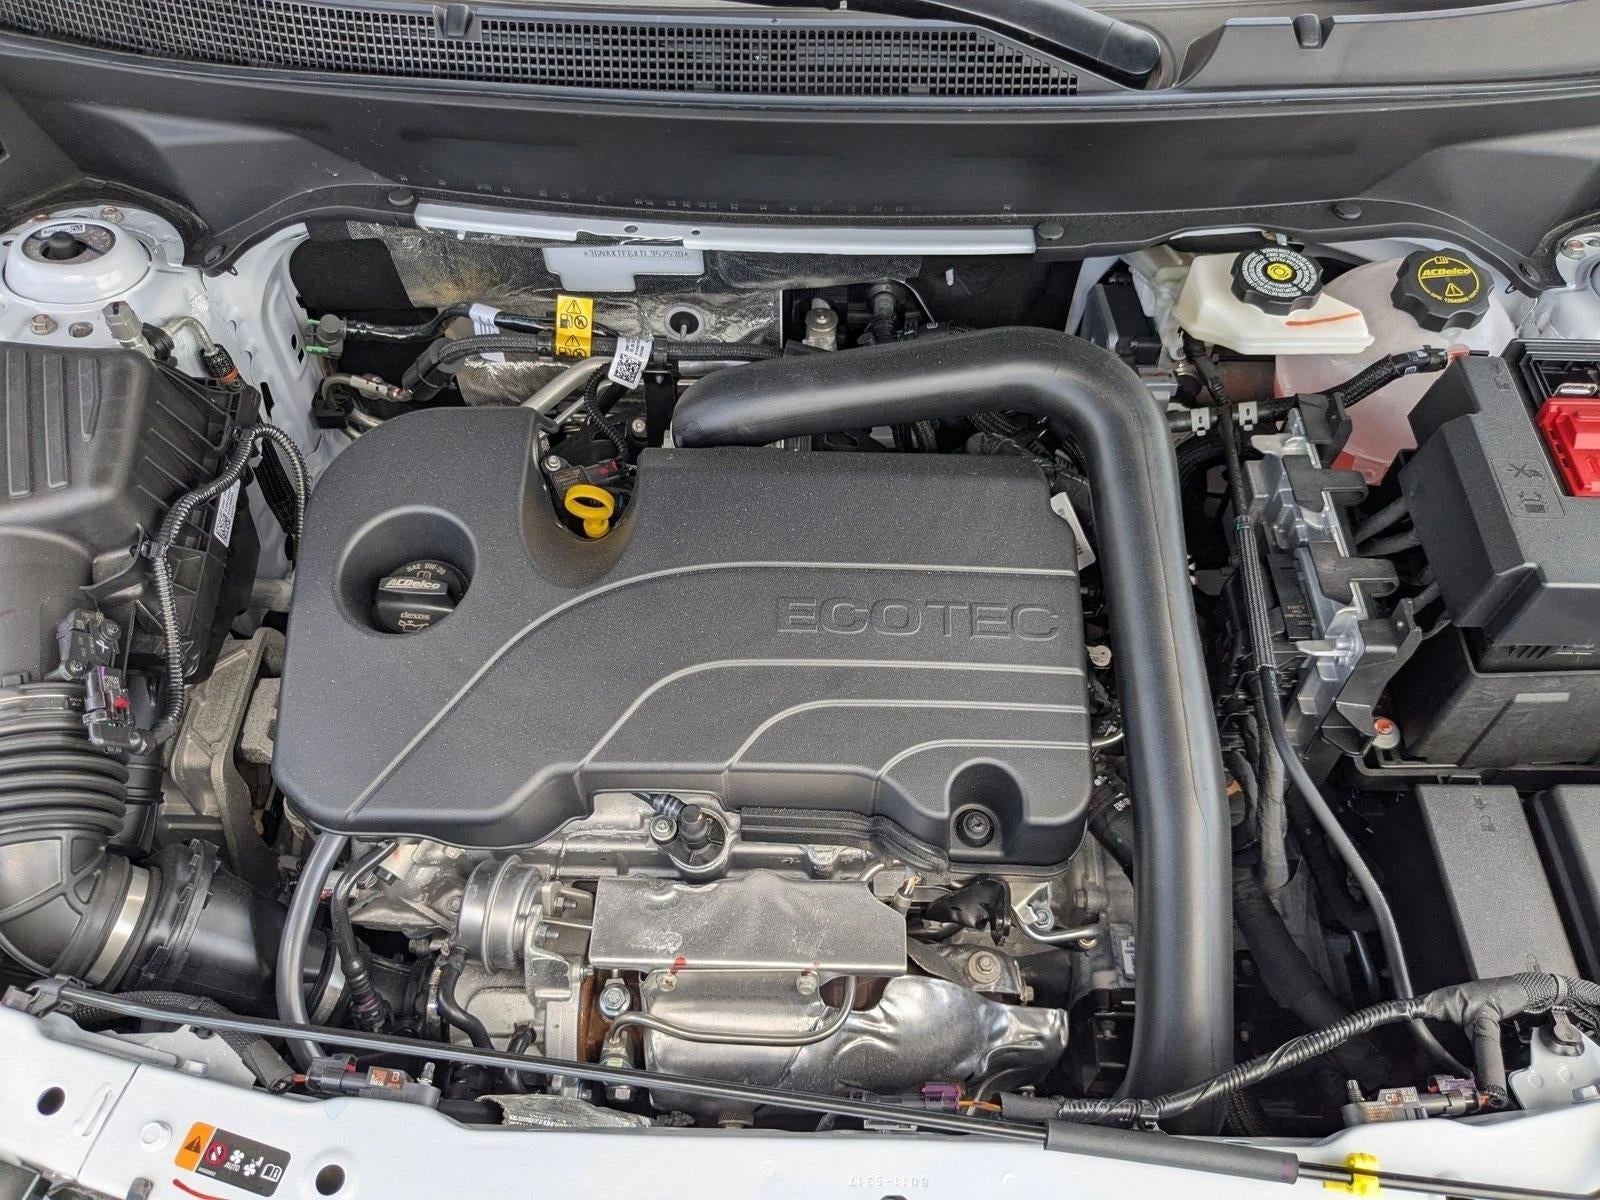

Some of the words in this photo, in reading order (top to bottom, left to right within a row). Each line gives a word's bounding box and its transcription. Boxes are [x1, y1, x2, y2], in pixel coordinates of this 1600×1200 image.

[1422, 267, 1472, 276] ACDelco
[406, 563, 421, 572] SAE
[384, 578, 441, 590] ACDelco
[400, 611, 431, 620] dexos
[776, 597, 1060, 642] ECOTEC
[224, 1161, 241, 1172] AUTO
